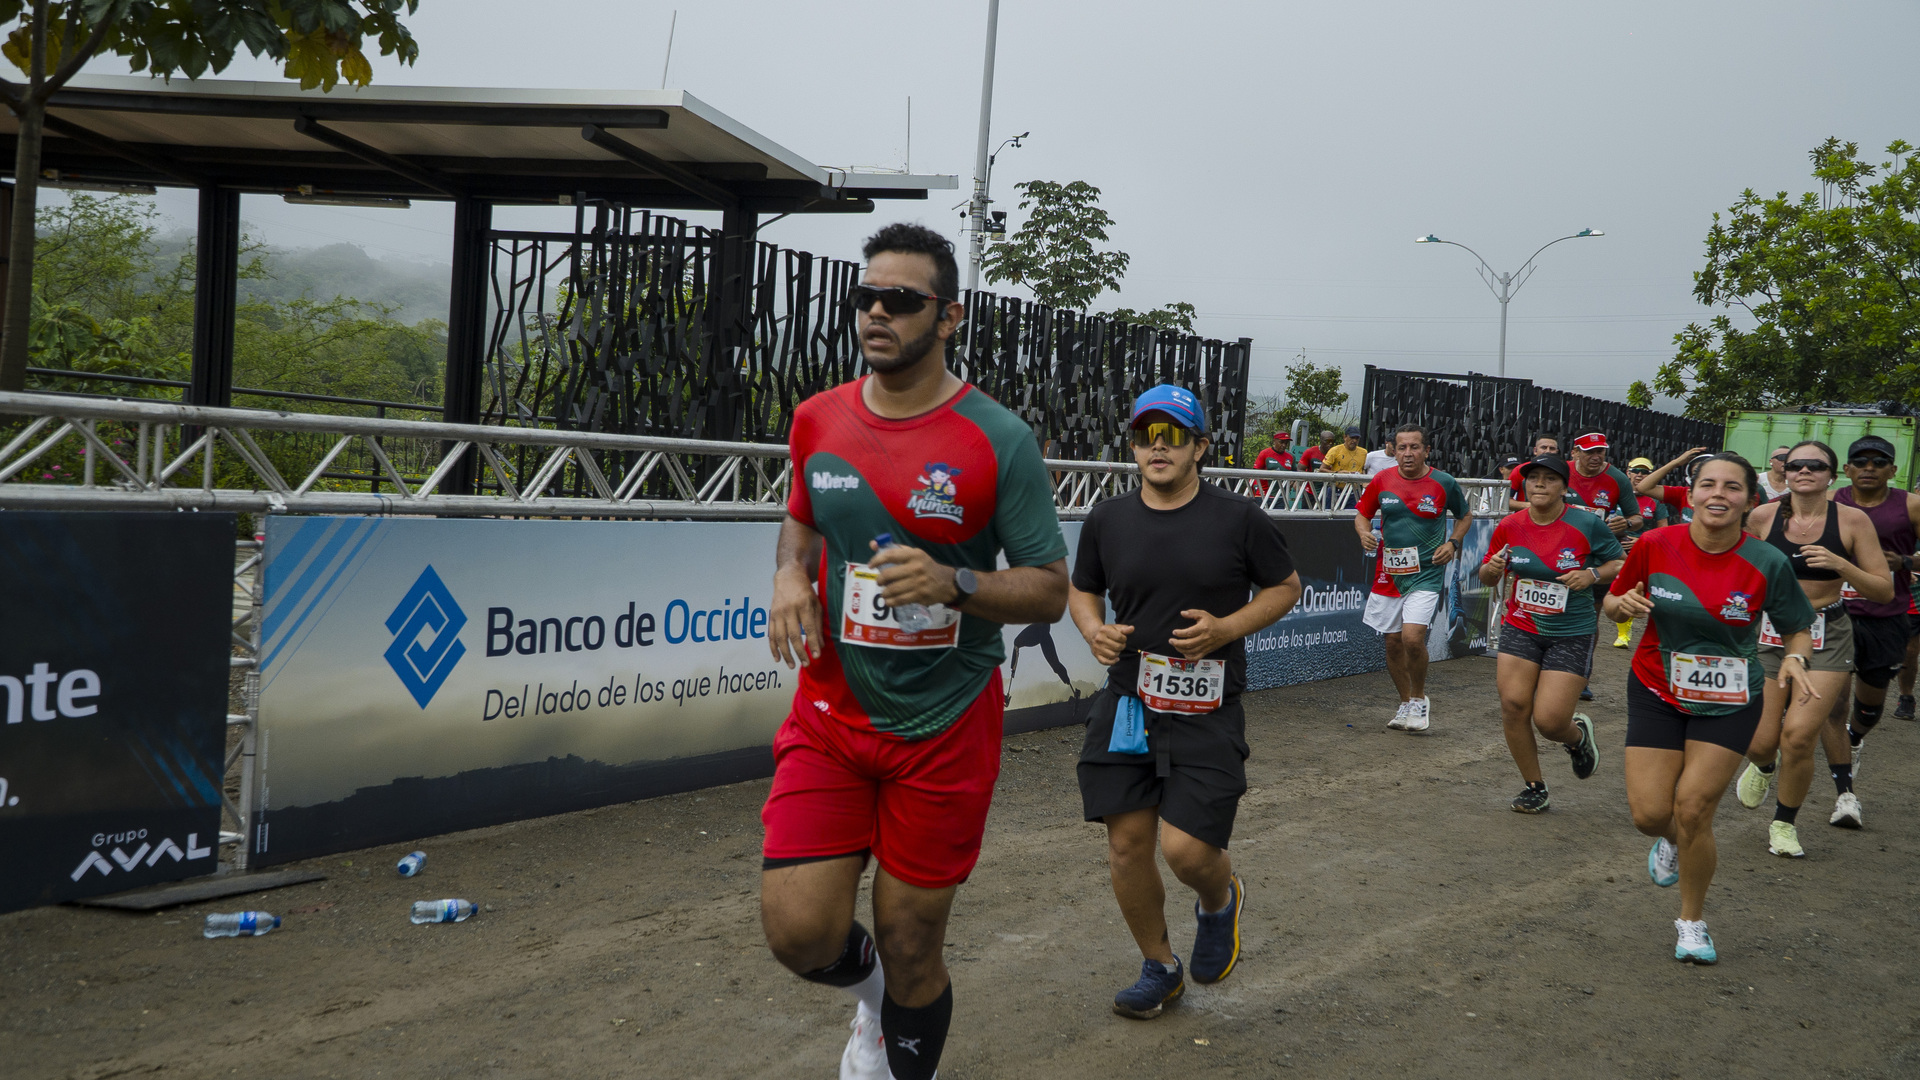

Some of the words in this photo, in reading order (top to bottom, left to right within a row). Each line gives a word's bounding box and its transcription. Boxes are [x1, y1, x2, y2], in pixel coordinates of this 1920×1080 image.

[1388, 556, 1408, 567] 134
[1303, 584, 1361, 613] Occidente
[1524, 589, 1557, 606] 1095
[486, 606, 605, 657] Banco
[614, 601, 655, 647] de
[664, 597, 770, 644] Occide
[1244, 633, 1255, 653] el
[1257, 632, 1276, 652] lado
[1278, 630, 1288, 648] de
[1291, 629, 1303, 647] los
[1305, 632, 1320, 649] que
[1322, 626, 1348, 644] hacen.
[1153, 673, 1209, 698] 1536
[1687, 670, 1726, 689] 440
[483, 684, 528, 721] Del
[535, 680, 591, 715] lado
[598, 676, 626, 707] de
[634, 673, 664, 704] los
[671, 676, 711, 707] que
[717, 666, 782, 694] hacen.
[92, 828, 148, 847] Grupo
[70, 833, 211, 882] AVAL
